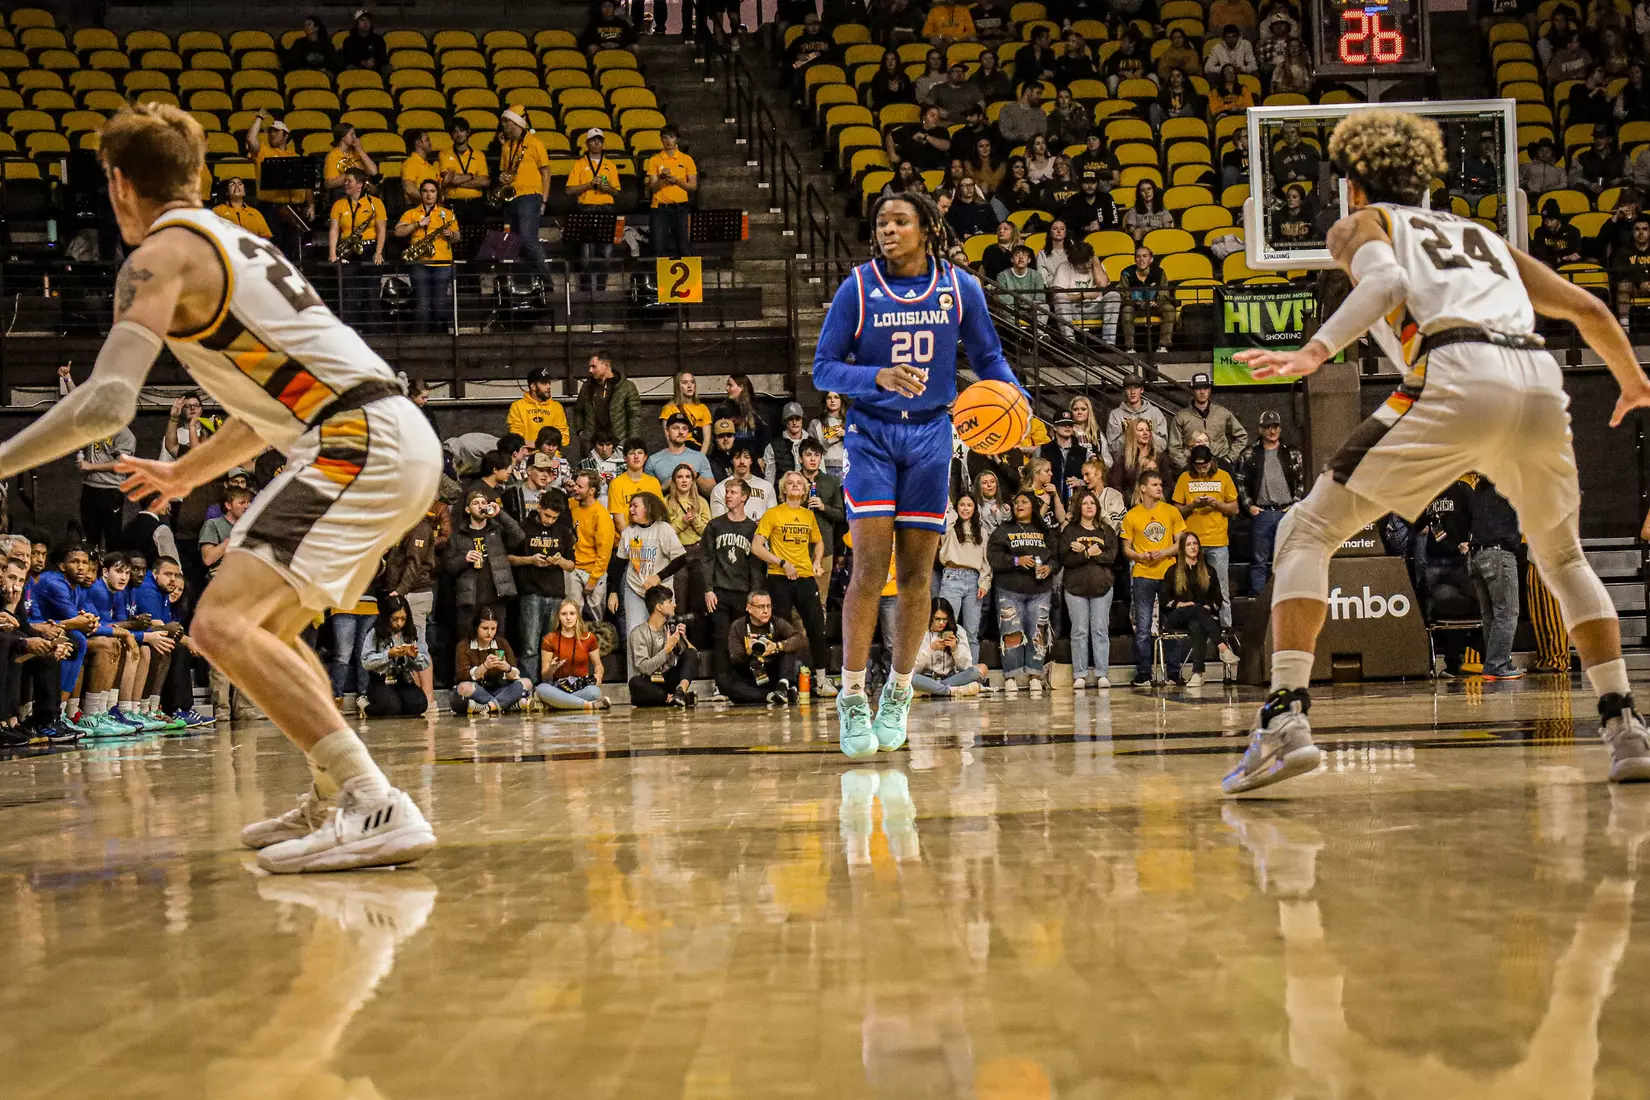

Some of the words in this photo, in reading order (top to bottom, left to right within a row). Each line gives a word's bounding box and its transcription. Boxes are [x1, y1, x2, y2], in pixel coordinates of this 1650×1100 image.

[1340, 9, 1402, 64] 26
[1409, 216, 1510, 280] 24
[669, 262, 691, 298] 2
[873, 310, 949, 327] LOUISIANA
[891, 330, 934, 363] 20
[1265, 332, 1302, 341] SHOOTING
[716, 533, 752, 556] WYOMING
[1011, 539, 1042, 548] COWBOYS
[1339, 539, 1376, 548] marter
[1328, 586, 1410, 620] fnbo
